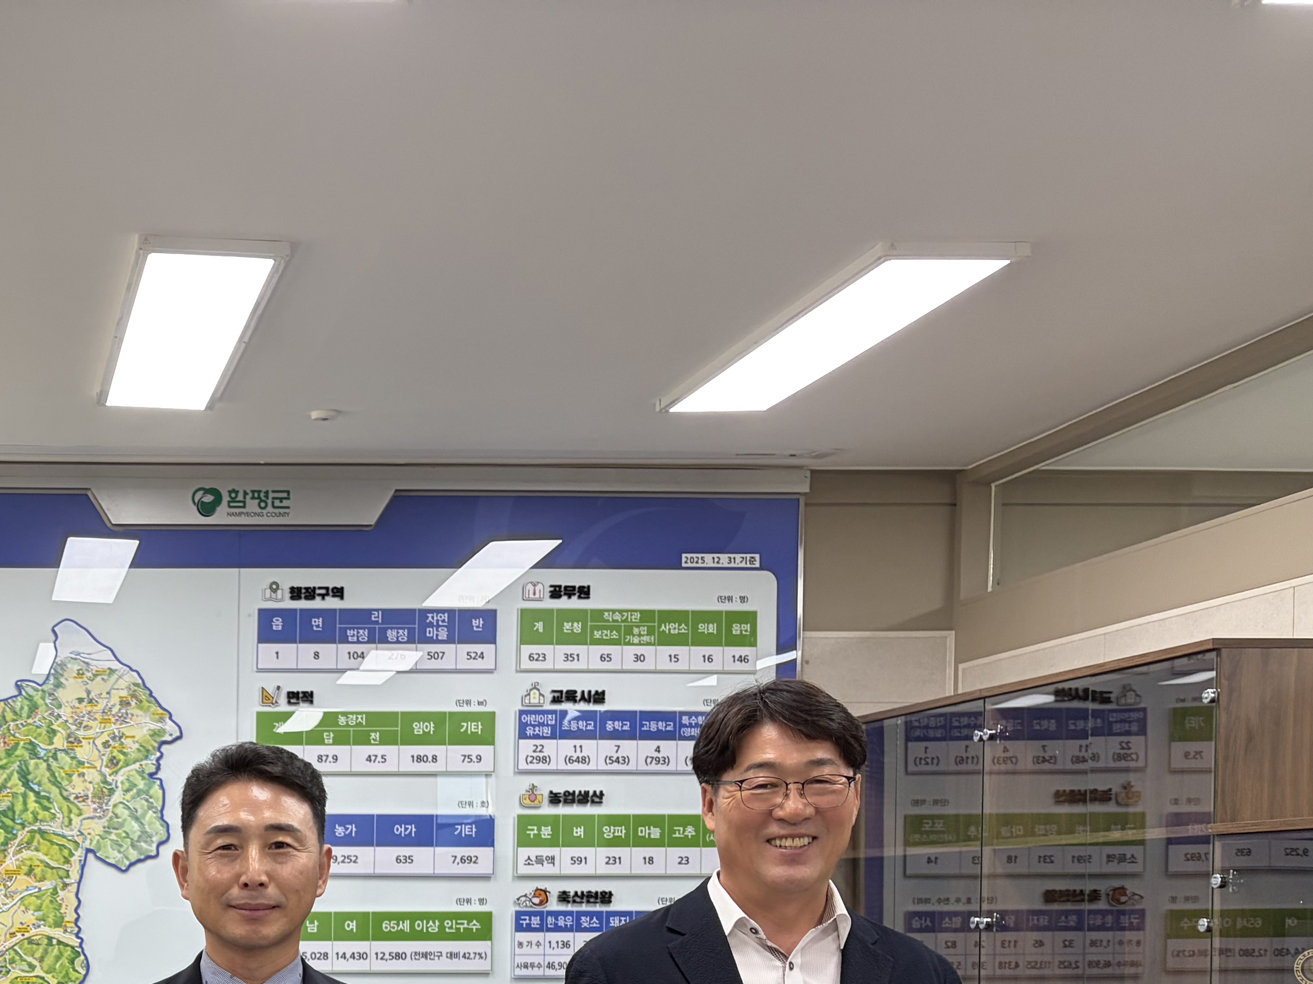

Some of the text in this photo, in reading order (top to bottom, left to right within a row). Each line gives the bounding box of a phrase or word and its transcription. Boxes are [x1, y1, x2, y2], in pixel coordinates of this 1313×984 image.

[227, 488, 290, 510] 함평군
[683, 556, 708, 565] 2025.
[712, 556, 724, 565] 12.
[289, 586, 345, 601] 행정구역
[549, 584, 591, 600] 공무원
[717, 595, 732, 604] (단위
[371, 611, 382, 623] 리
[426, 613, 449, 625] 자연
[603, 611, 640, 622] 직속기관
[272, 618, 283, 630] 읍
[311, 618, 323, 630] 면
[472, 618, 484, 631] 반
[533, 622, 543, 633] 계
[563, 622, 582, 633] 본청
[660, 623, 688, 634] 사업소
[698, 623, 717, 634] 의회
[731, 623, 751, 635] 읍면
[347, 630, 368, 642] 법정
[387, 630, 408, 642] 행정
[426, 627, 449, 640] 마을
[593, 630, 619, 640] 보건소
[632, 626, 648, 635] 농업
[625, 635, 655, 644] 기술센터
[274, 651, 280, 660] 1
[313, 651, 320, 660] 8
[347, 651, 365, 660] 104
[426, 651, 445, 660] 507
[466, 651, 484, 660] 524
[528, 653, 547, 662] 623
[563, 653, 581, 662] 351
[599, 653, 612, 662] 65
[632, 653, 645, 663] 30
[668, 654, 679, 663] 15
[702, 654, 714, 663] 16
[731, 654, 750, 664] 146
[287, 691, 314, 705] 면적
[550, 690, 606, 705] 교육시설
[337, 714, 366, 725] 농경지
[521, 714, 555, 725] 어린이집
[413, 722, 435, 735] 임야
[460, 722, 482, 735] 기타
[561, 720, 595, 731] 초등학교
[605, 720, 630, 732] 중학교
[641, 721, 674, 732] 고등학교
[525, 726, 551, 737] 유치원
[323, 732, 334, 744] 답
[369, 732, 380, 744] 전
[532, 745, 544, 753] 22
[573, 745, 584, 753] 11
[614, 745, 620, 754] 7
[654, 745, 661, 754] 4
[317, 754, 338, 764] 87.9
[366, 754, 387, 764] 47.5
[410, 754, 438, 764] 180.8
[461, 754, 482, 764] 75.9
[525, 755, 551, 766] (298)
[564, 755, 591, 766] (648)
[604, 755, 630, 766] (543)
[644, 755, 670, 766] (793)
[548, 790, 605, 805] 농업생산
[334, 824, 357, 837] 농가
[394, 824, 416, 837] 어가
[454, 824, 477, 837] 기타
[573, 826, 584, 839] 벼
[603, 826, 626, 839] 양파
[638, 826, 662, 839] 마늘
[672, 826, 696, 839] 고추
[331, 855, 358, 865] 9,252
[395, 855, 414, 865] 635
[451, 855, 479, 866] 7,692
[523, 855, 556, 867] 소득액
[570, 856, 588, 866] 591
[605, 856, 622, 866] 231
[642, 856, 654, 866] 18
[677, 856, 690, 866] 23
[557, 890, 614, 905] 축산현황
[306, 920, 318, 932] 남
[344, 920, 356, 933] 여
[382, 920, 481, 933] 65세 이상 인구수
[519, 916, 541, 928] 구분
[580, 916, 600, 928] 젖소
[609, 916, 630, 928] 돼지
[547, 940, 571, 951] 1,136
[301, 951, 329, 962] 5,028
[335, 951, 368, 962] 14,430
[374, 951, 407, 962] 12,580
[461, 951, 488, 962] 42.7%)
[546, 961, 567, 971] 46,90
